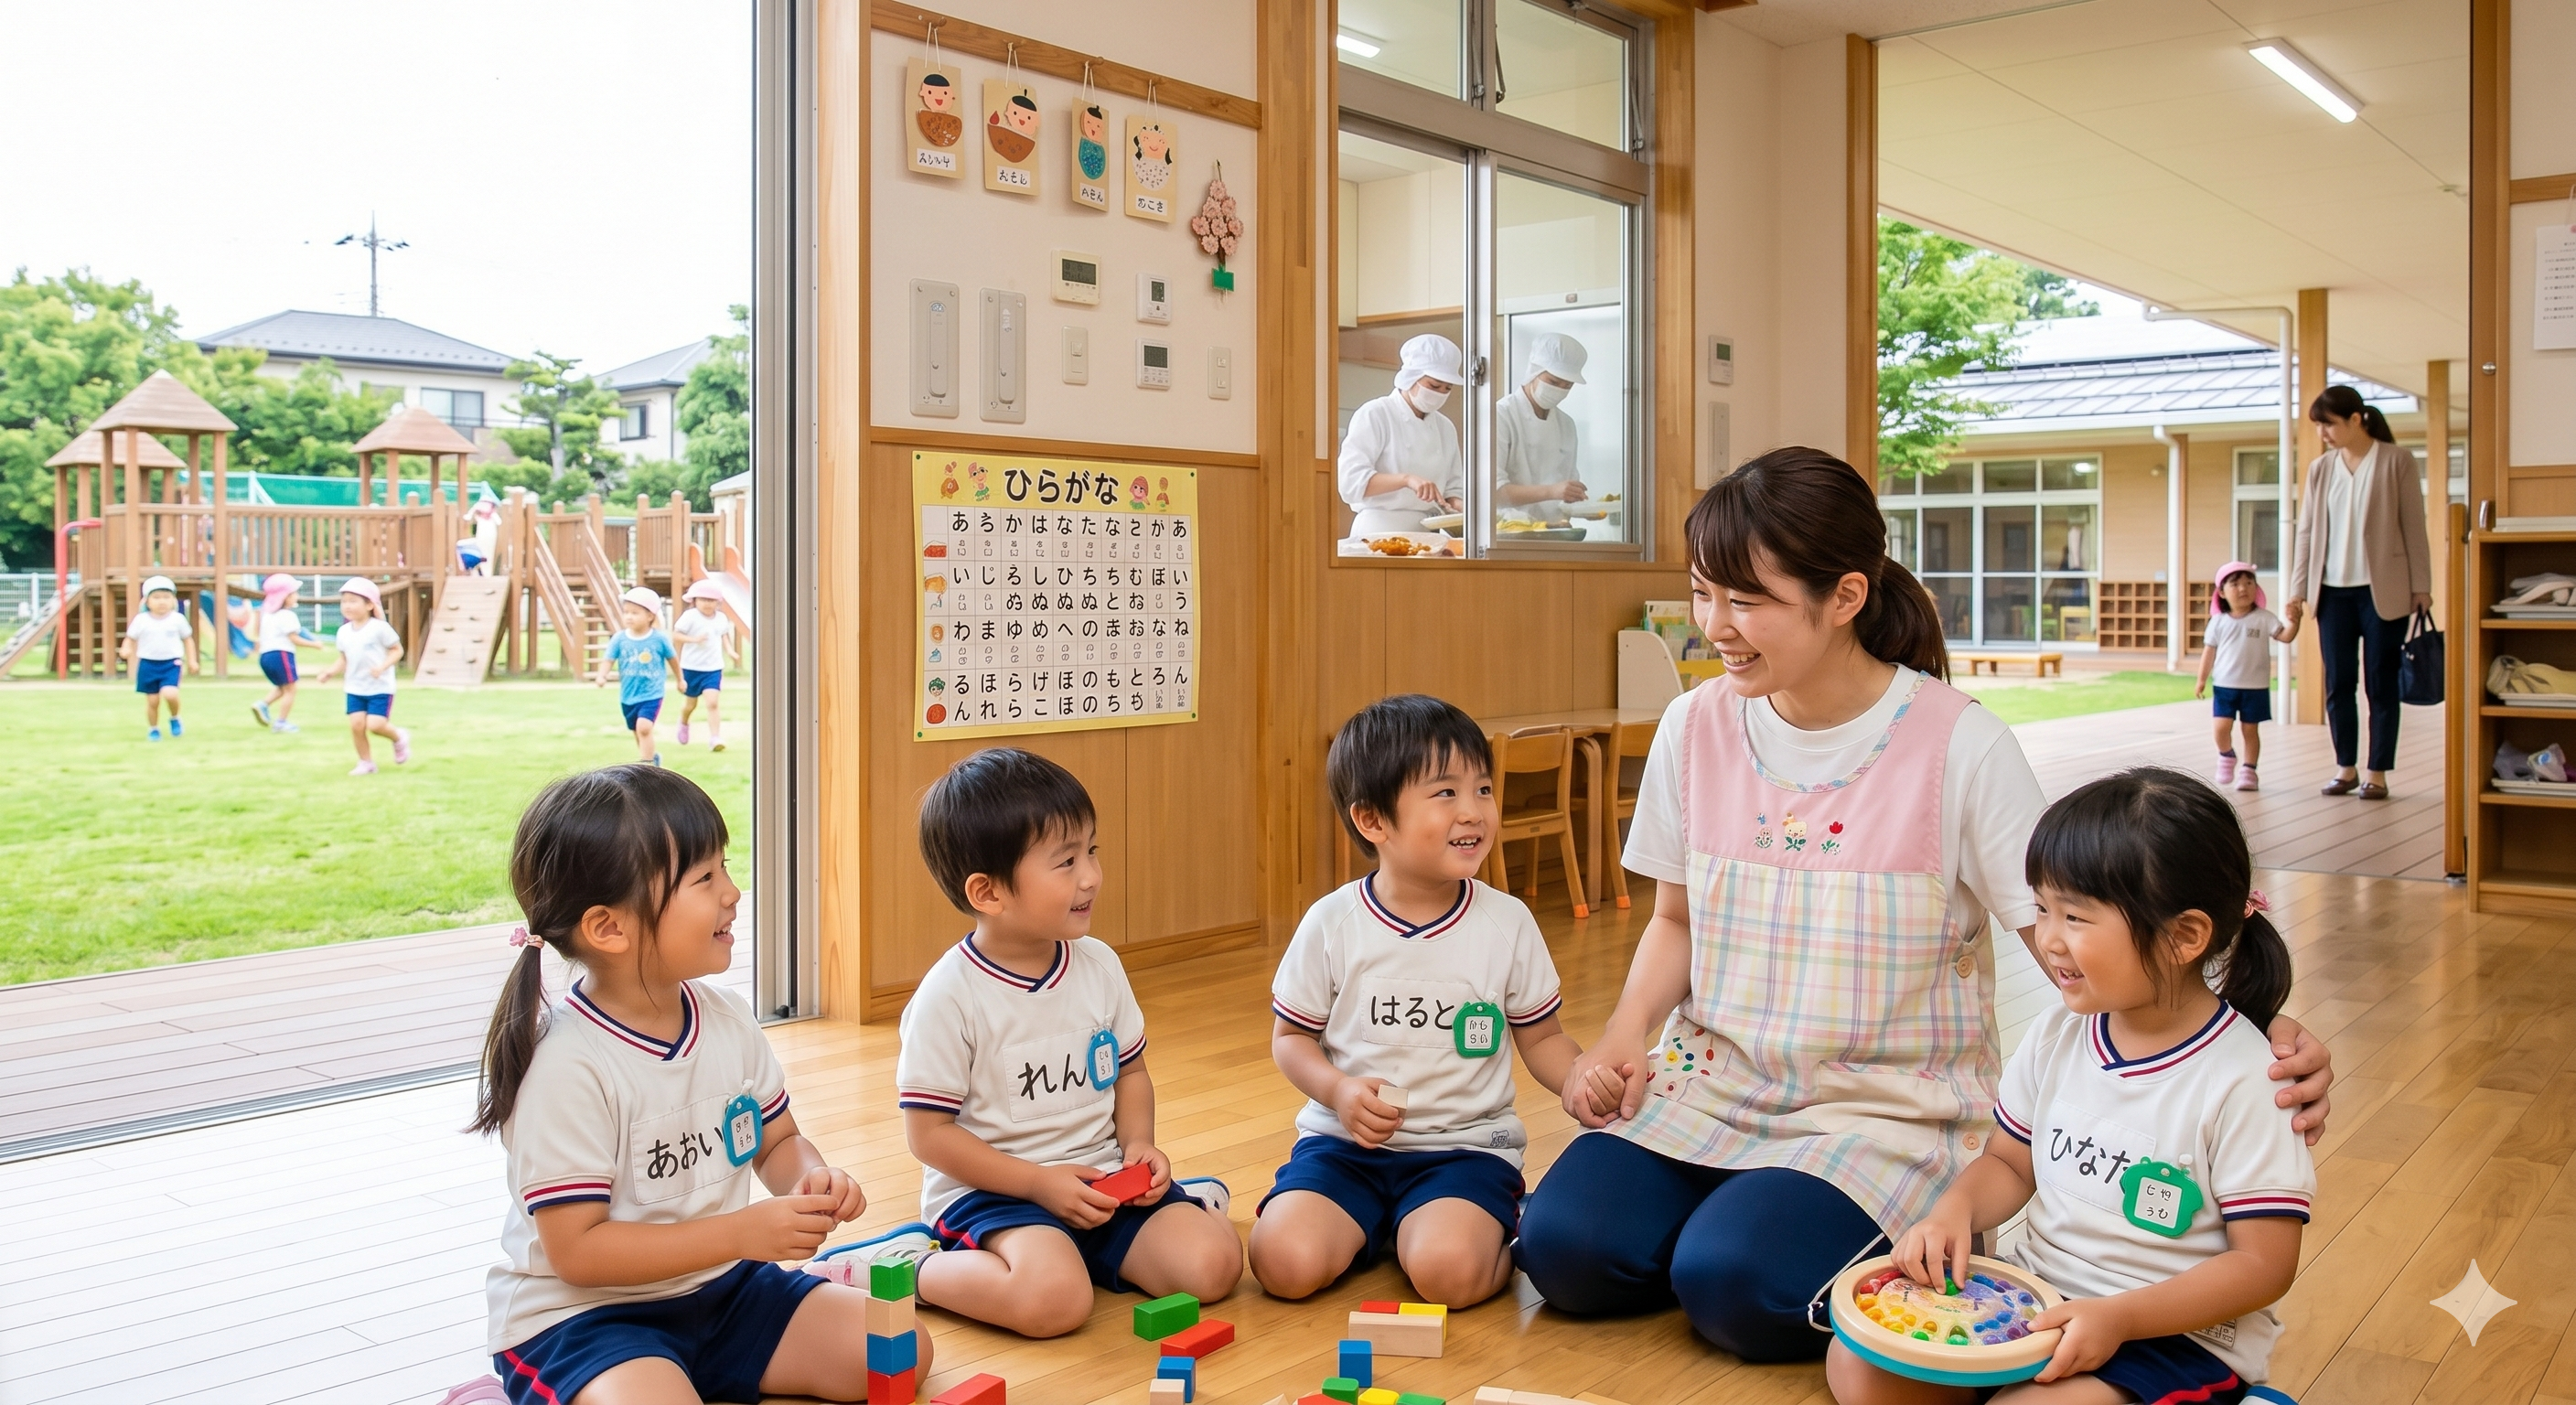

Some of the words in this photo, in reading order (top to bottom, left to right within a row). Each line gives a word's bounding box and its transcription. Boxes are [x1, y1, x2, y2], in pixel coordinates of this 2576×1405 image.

[1004, 468, 1119, 505] ひらがな
[952, 510, 969, 532] あ
[1005, 513, 1023, 533] か
[1032, 514, 1048, 534] は
[1057, 515, 1073, 535] な
[1081, 515, 1097, 536] た
[1105, 517, 1121, 537] な
[1173, 519, 1187, 539] あ
[953, 567, 970, 585] い
[1034, 566, 1047, 586] し
[1057, 567, 1074, 585] ひ
[1082, 566, 1097, 586] ち
[1106, 566, 1120, 586] ち
[1173, 569, 1188, 585] い
[1031, 592, 1049, 611] ぬ
[1057, 592, 1074, 611] ぬ
[1081, 592, 1099, 611] ぬ
[1106, 592, 1120, 611] と
[1175, 591, 1186, 610] う
[981, 619, 995, 640] ま
[1007, 619, 1023, 640] ゆ
[1032, 619, 1048, 639] め
[1057, 623, 1074, 637] へ
[1082, 620, 1099, 638] の
[1152, 617, 1166, 638] な
[1174, 617, 1189, 637] ね
[954, 674, 970, 695] る
[1008, 672, 1022, 692] ら
[1082, 670, 1098, 689] の
[1106, 669, 1121, 689] も
[1131, 667, 1143, 687] と
[1153, 667, 1165, 686] ろ
[1174, 665, 1188, 684] ん
[954, 701, 971, 722] ん
[980, 699, 998, 720] れ
[1008, 698, 1022, 719] ら
[1034, 698, 1047, 716] こ
[1082, 695, 1098, 713] の
[1107, 693, 1121, 713] ち
[1370, 995, 1454, 1030] はると
[1018, 1054, 1086, 1100] れん
[648, 1128, 724, 1179] あおい
